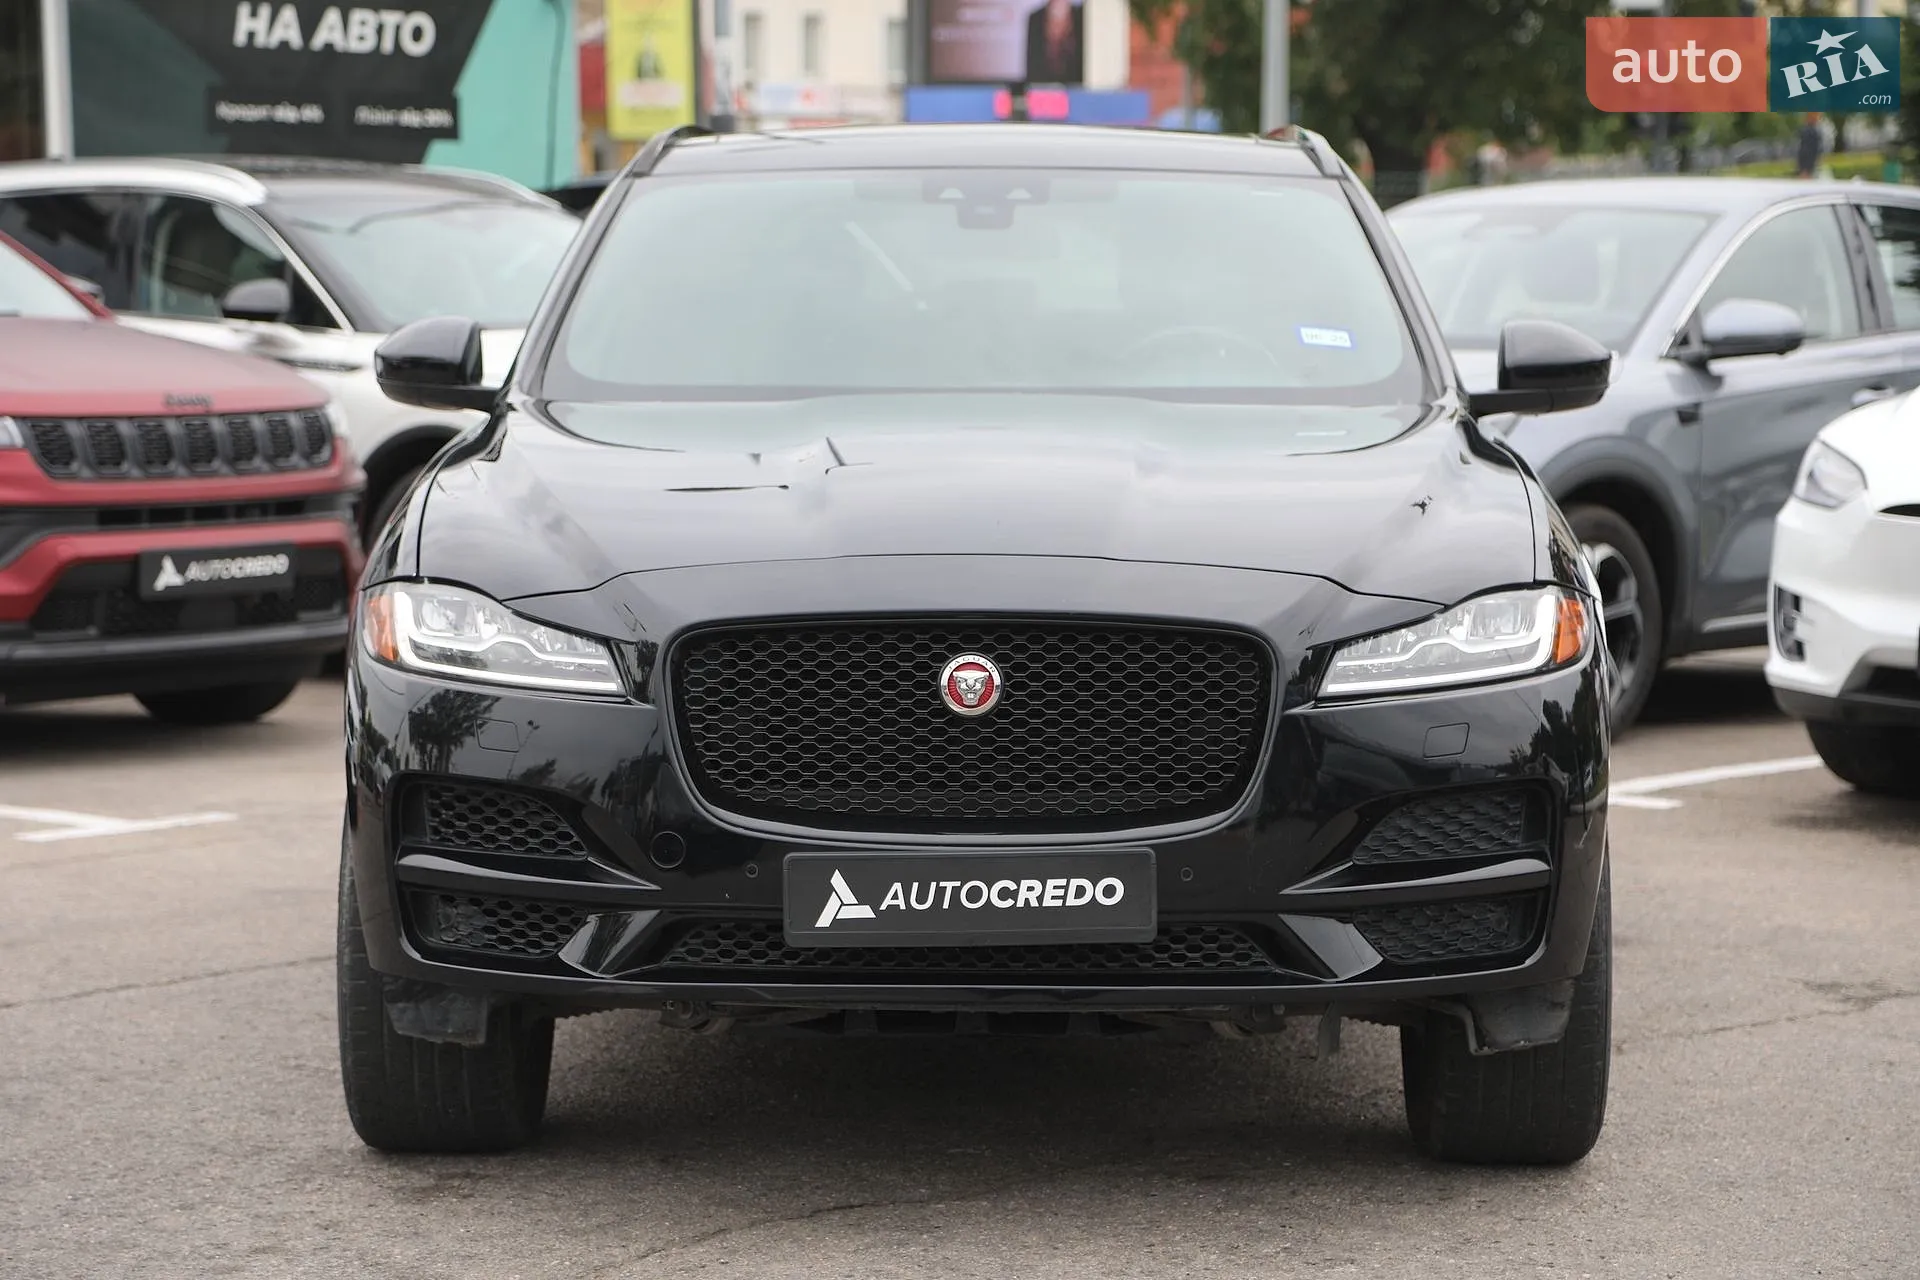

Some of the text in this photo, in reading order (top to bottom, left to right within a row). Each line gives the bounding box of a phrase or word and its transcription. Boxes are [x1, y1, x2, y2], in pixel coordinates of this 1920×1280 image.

[233, 1, 437, 58] НА АВТО
[184, 553, 290, 582] AUTOCREDO
[947, 656, 996, 673] JAGUAR
[879, 877, 1125, 911] AUTOCREDO
